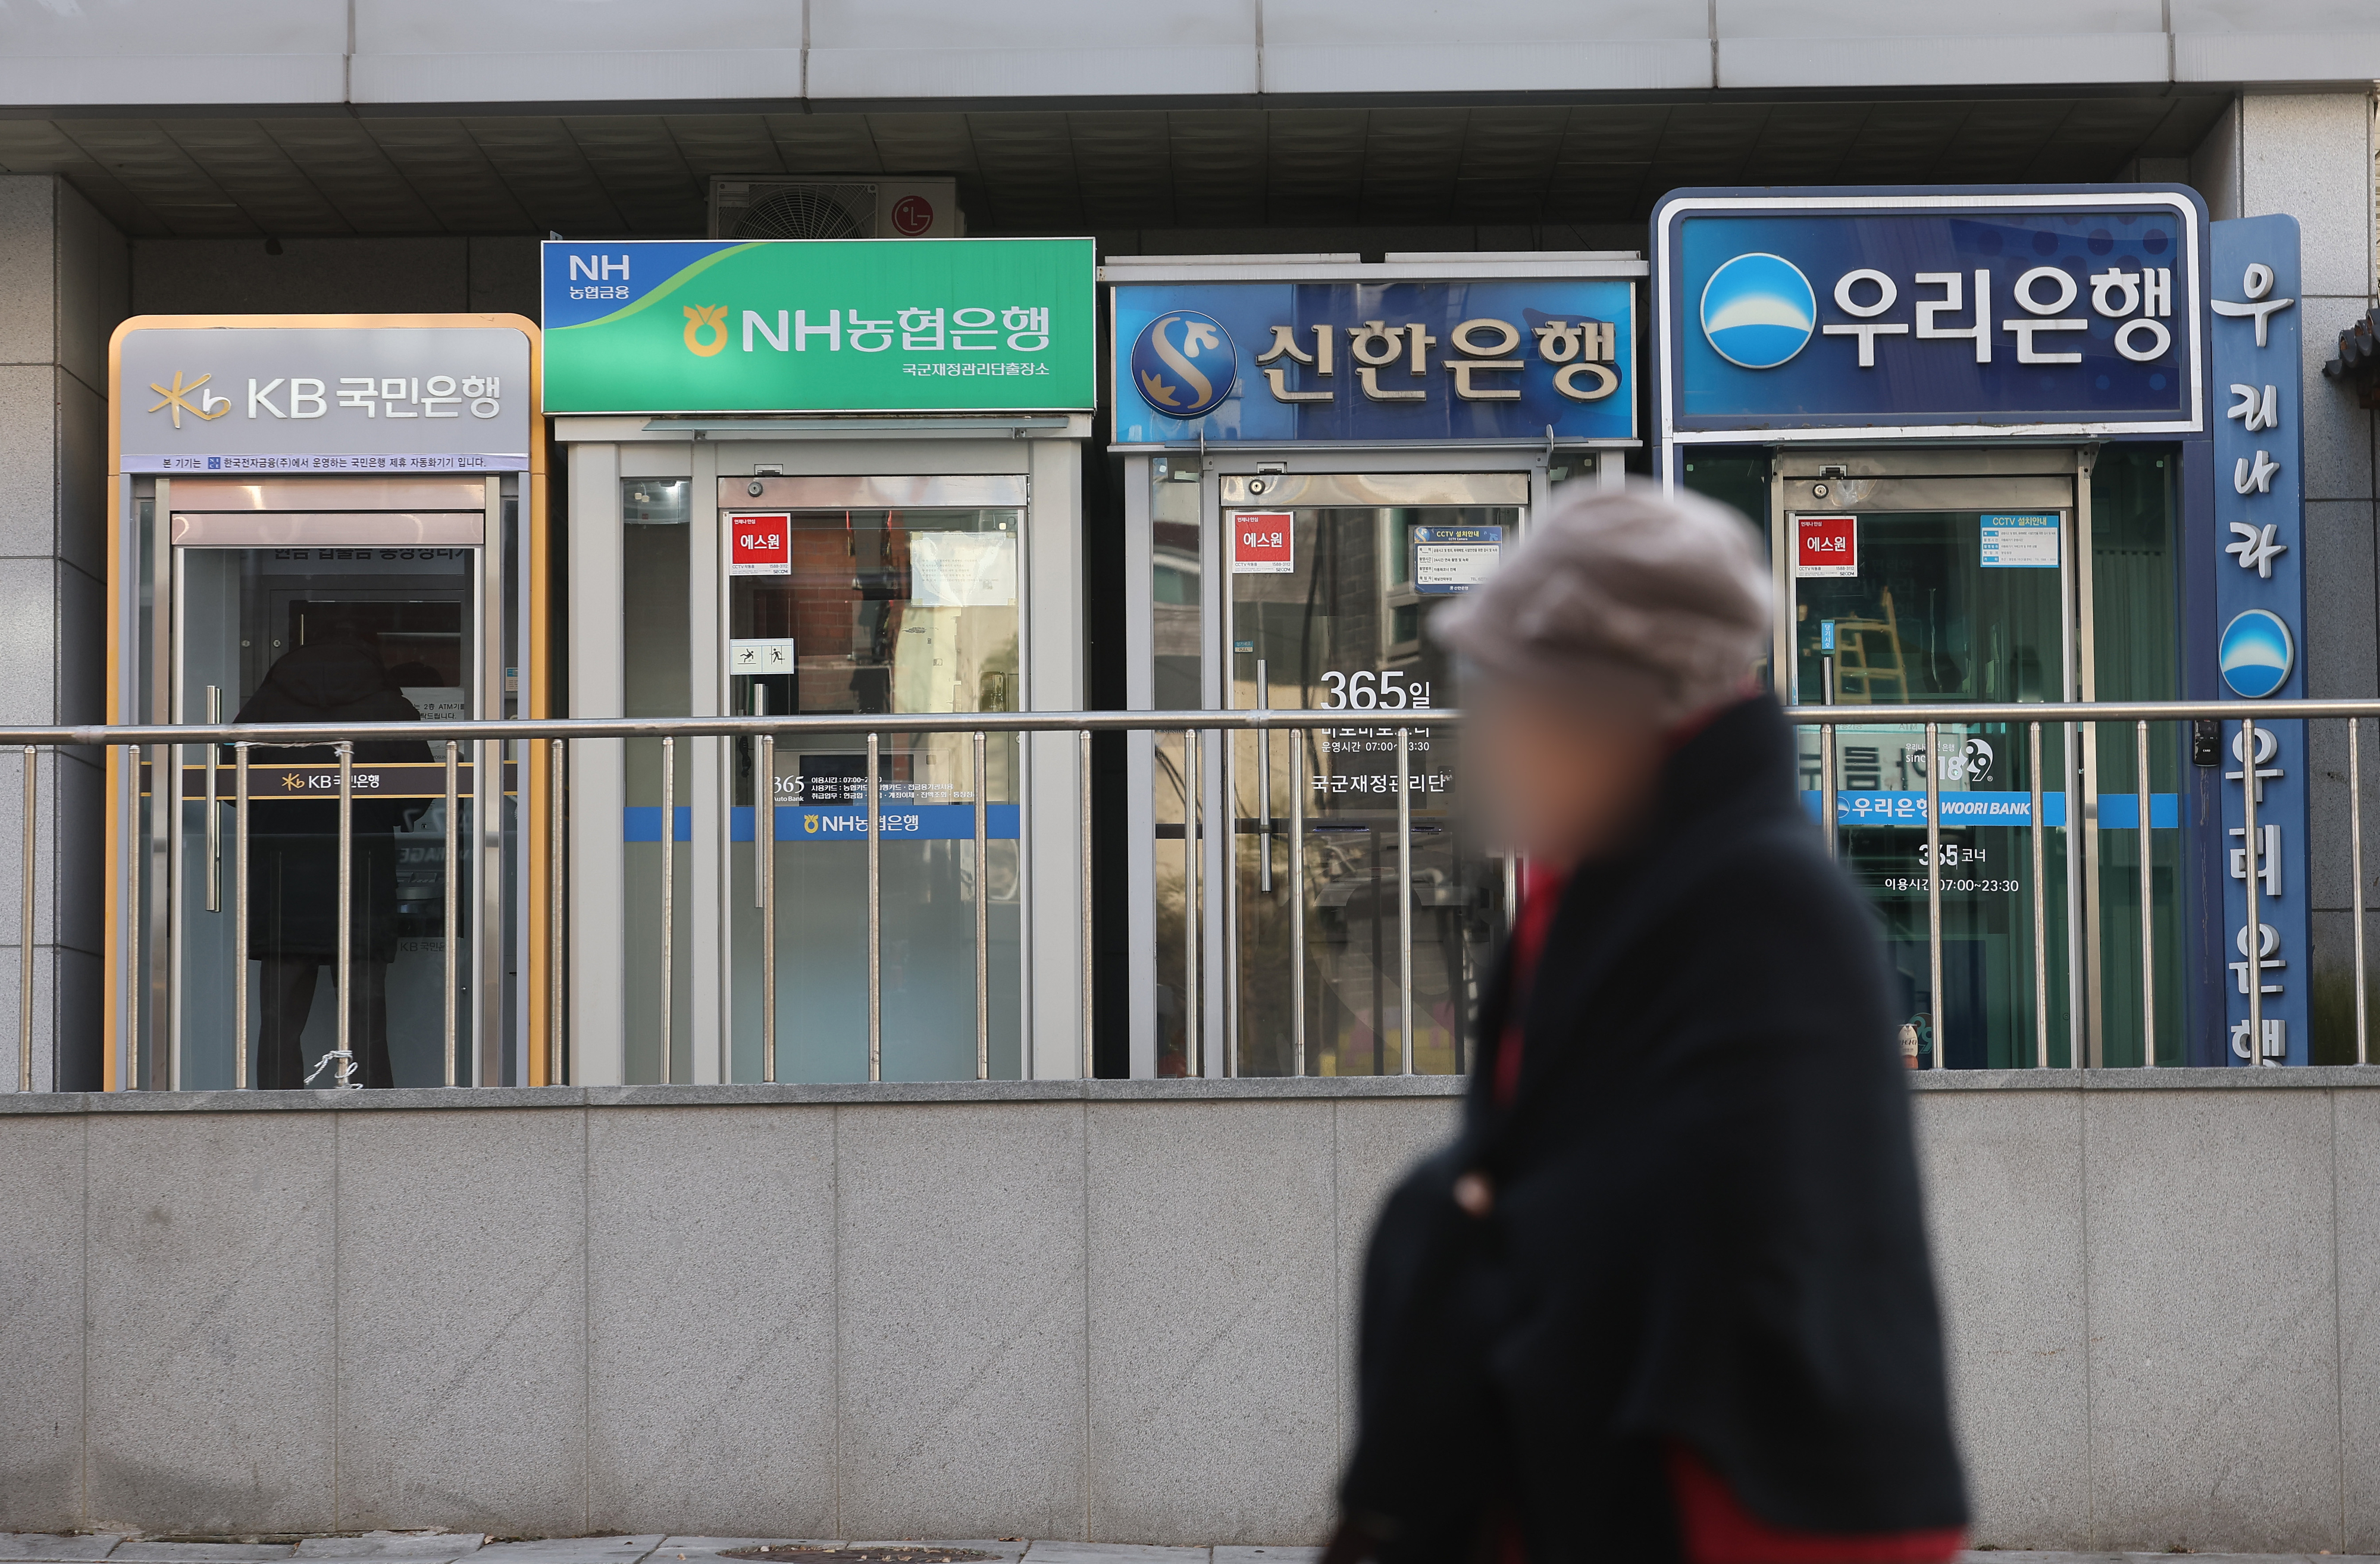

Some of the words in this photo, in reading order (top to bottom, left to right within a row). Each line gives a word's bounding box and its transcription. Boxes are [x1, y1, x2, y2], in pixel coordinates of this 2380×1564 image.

[569, 255, 630, 281] NH
[569, 285, 630, 300] 농협금융
[1822, 266, 2171, 367] 우리은행
[742, 306, 1050, 353] NH농협은행
[1256, 318, 1618, 402] 신한은행
[902, 362, 1050, 377] 국군재정관리단출장소
[162, 457, 171, 468] 본
[176, 458, 202, 468] 기기는
[224, 457, 309, 468] 한국전자금융(주)에서
[312, 457, 347, 468] 운영하는
[351, 457, 386, 468] 국민은행
[390, 457, 407, 468] 제휴
[410, 457, 453, 468] 자동화기기
[458, 457, 486, 468] 입니다.
[1993, 517, 2015, 525] CCTV
[2018, 516, 2047, 526] 설치안내
[740, 534, 779, 550] 에스원
[1243, 532, 1282, 547] 에스원
[1807, 536, 1846, 552] 에스원
[1321, 741, 1361, 753] 운영시간
[1366, 741, 1430, 751] 07:00~3:30
[1905, 743, 1925, 751] 우리나
[1941, 743, 1955, 752] 은행
[1905, 754, 1926, 763] sinc
[774, 775, 804, 794] 365
[1941, 802, 1988, 815] WOORI
[1989, 803, 2031, 815] BANK
[1961, 848, 1986, 863] 코너
